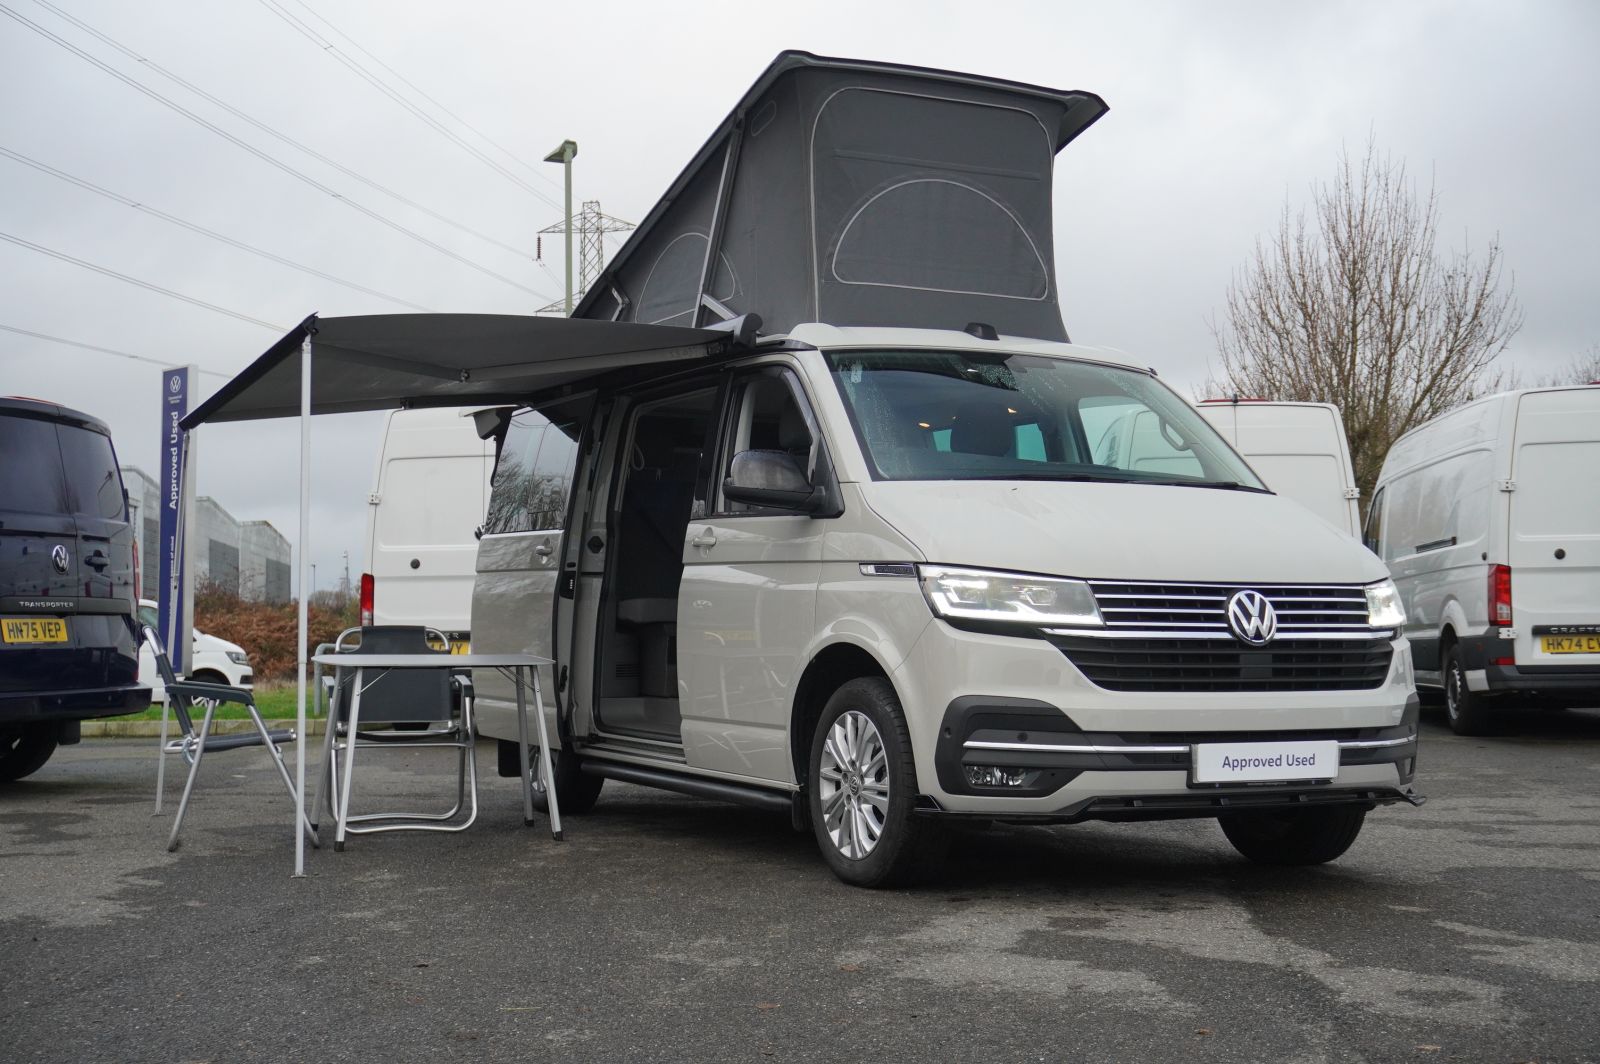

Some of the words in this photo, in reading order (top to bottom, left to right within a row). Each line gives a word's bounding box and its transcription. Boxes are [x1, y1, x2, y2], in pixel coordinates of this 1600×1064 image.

[170, 411, 179, 444] Used
[169, 447, 178, 510] Approved
[7, 621, 39, 640] HN75
[40, 621, 62, 639] VEP
[1546, 638, 1583, 650] HK74
[1222, 754, 1282, 771] Approved
[1286, 753, 1316, 767] Used
